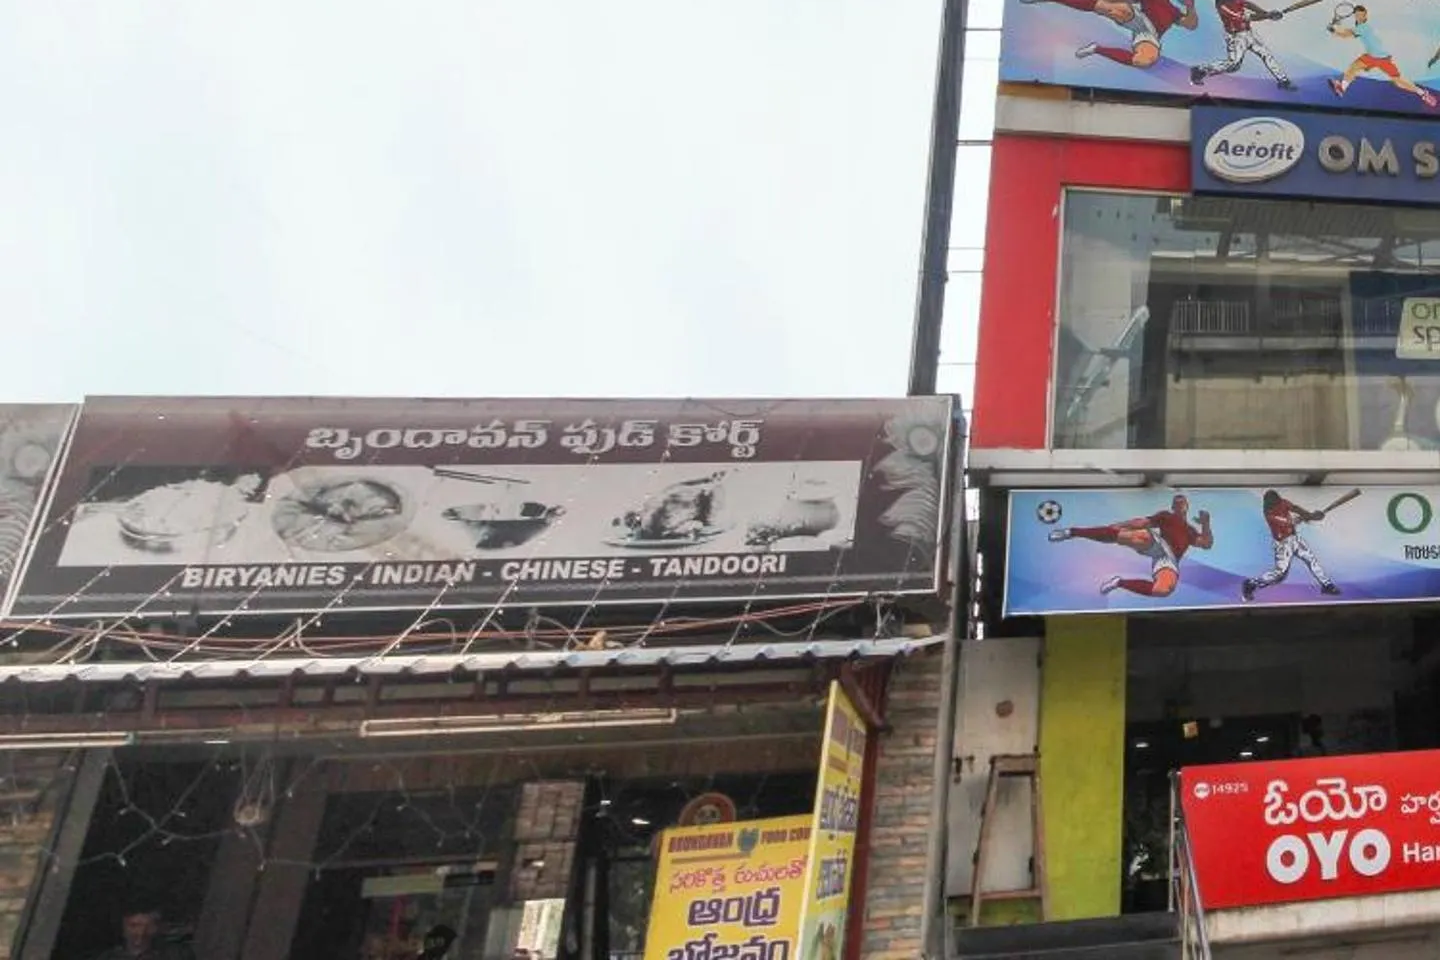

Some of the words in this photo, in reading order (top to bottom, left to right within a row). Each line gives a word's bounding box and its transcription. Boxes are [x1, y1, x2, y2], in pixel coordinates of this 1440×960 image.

[1213, 139, 1295, 161] Aerofit
[1317, 134, 1401, 177] OM
[305, 418, 552, 460] బృందావన్
[181, 565, 348, 589] BIRYANIES
[370, 562, 478, 586] INDIAN
[500, 558, 627, 582] CHINESE
[650, 554, 788, 578] TANDOORI
[1263, 777, 1388, 826] ఓయో
[1266, 828, 1392, 885] OYO
[687, 886, 781, 927] ఆంధ్ర
